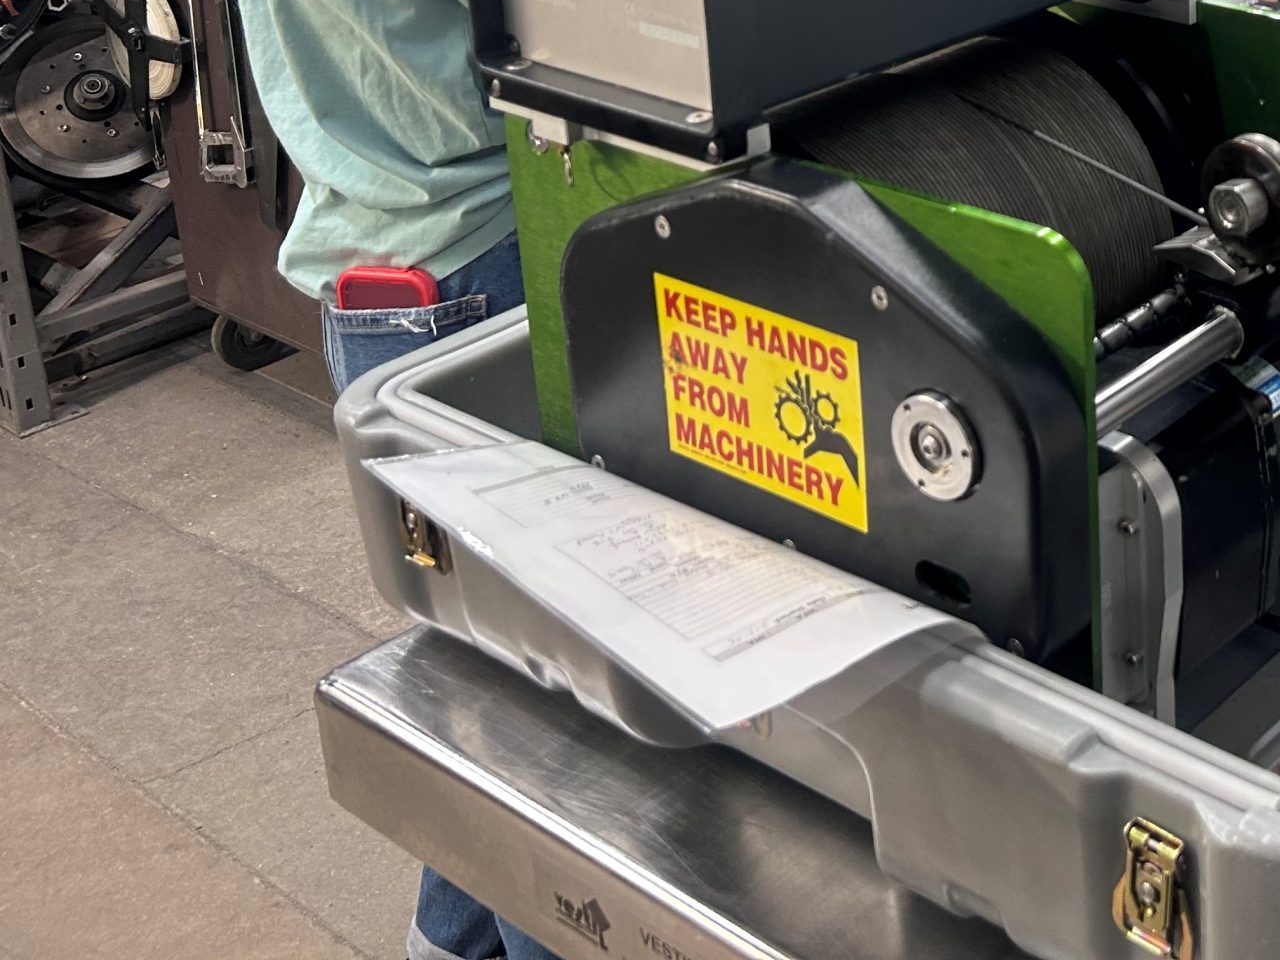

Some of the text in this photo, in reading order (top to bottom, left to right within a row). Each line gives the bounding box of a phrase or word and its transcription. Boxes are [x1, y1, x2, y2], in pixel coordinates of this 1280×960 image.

[663, 287, 850, 382] KEEP HANDS
[668, 331, 749, 386] AWAY
[672, 372, 751, 428] FROM
[675, 412, 845, 507] MACHINERY
